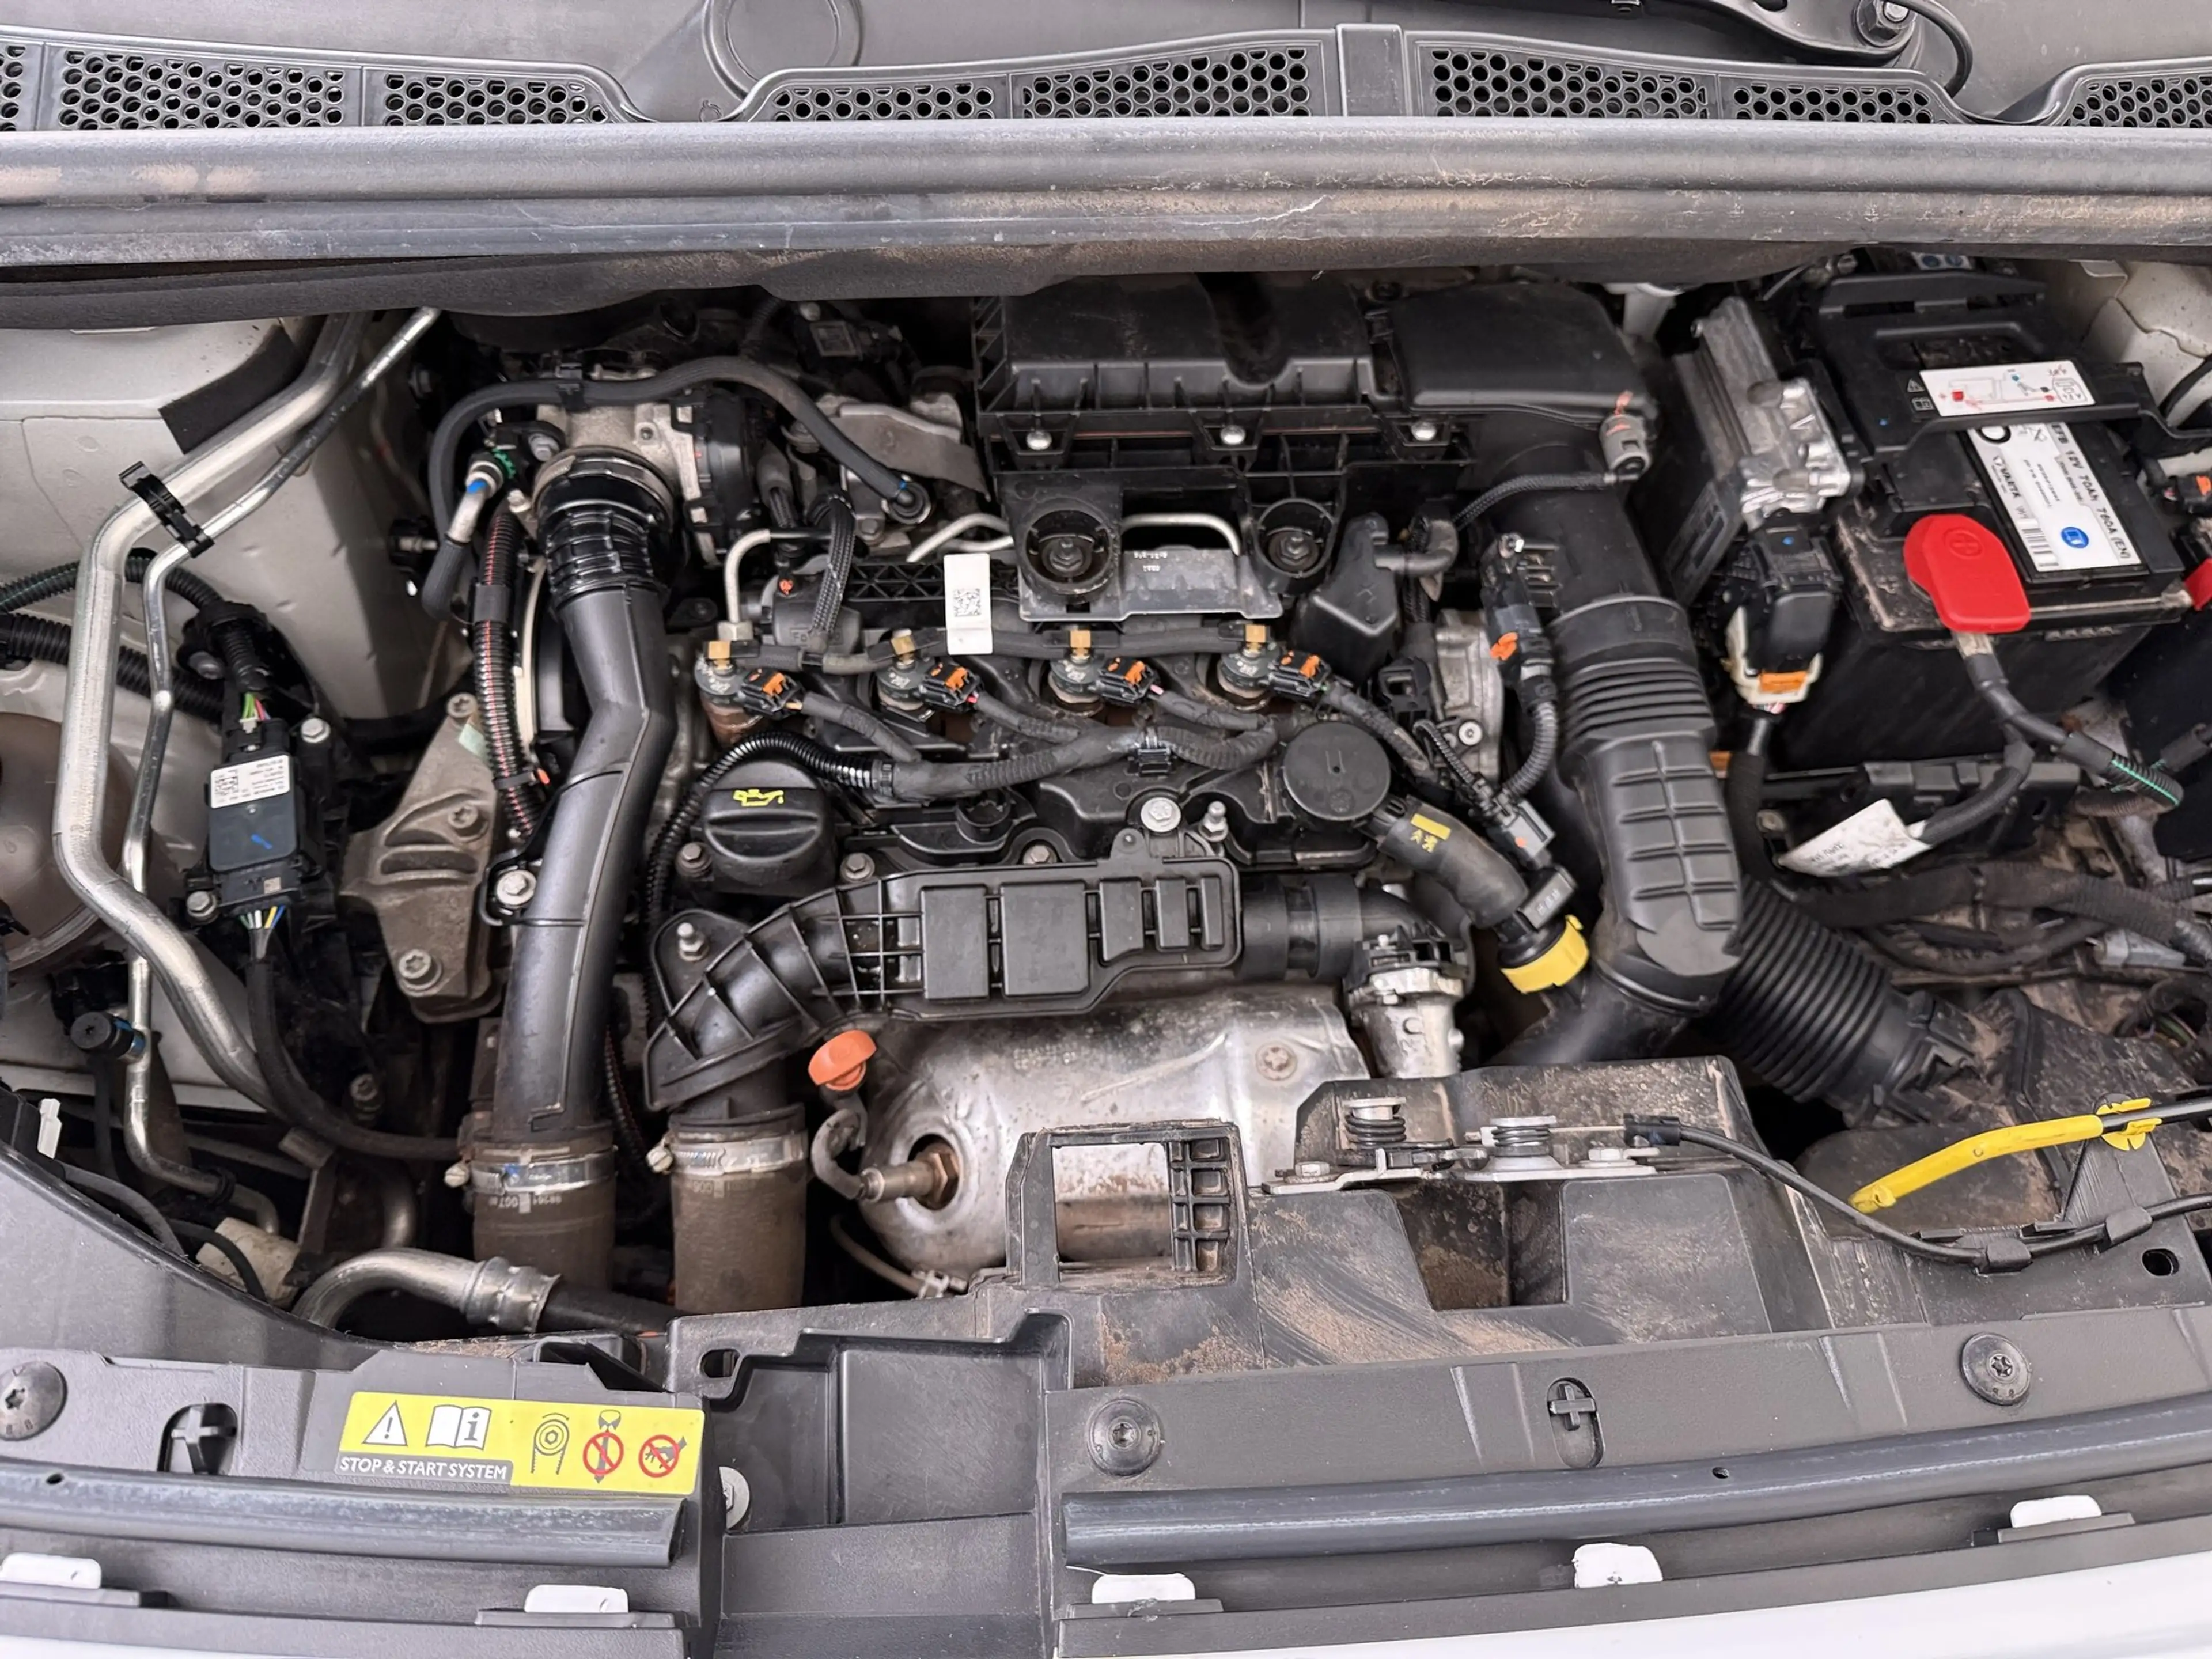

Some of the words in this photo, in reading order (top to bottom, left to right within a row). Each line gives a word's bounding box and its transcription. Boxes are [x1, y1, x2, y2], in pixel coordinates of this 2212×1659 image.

[2065, 450, 2084, 469] 12V
[2078, 475, 2099, 502] 70Ah
[340, 1457, 381, 1473] STOP
[382, 1459, 395, 1475] &
[397, 1460, 447, 1478] START
[448, 1463, 507, 1479] SYSTEM
